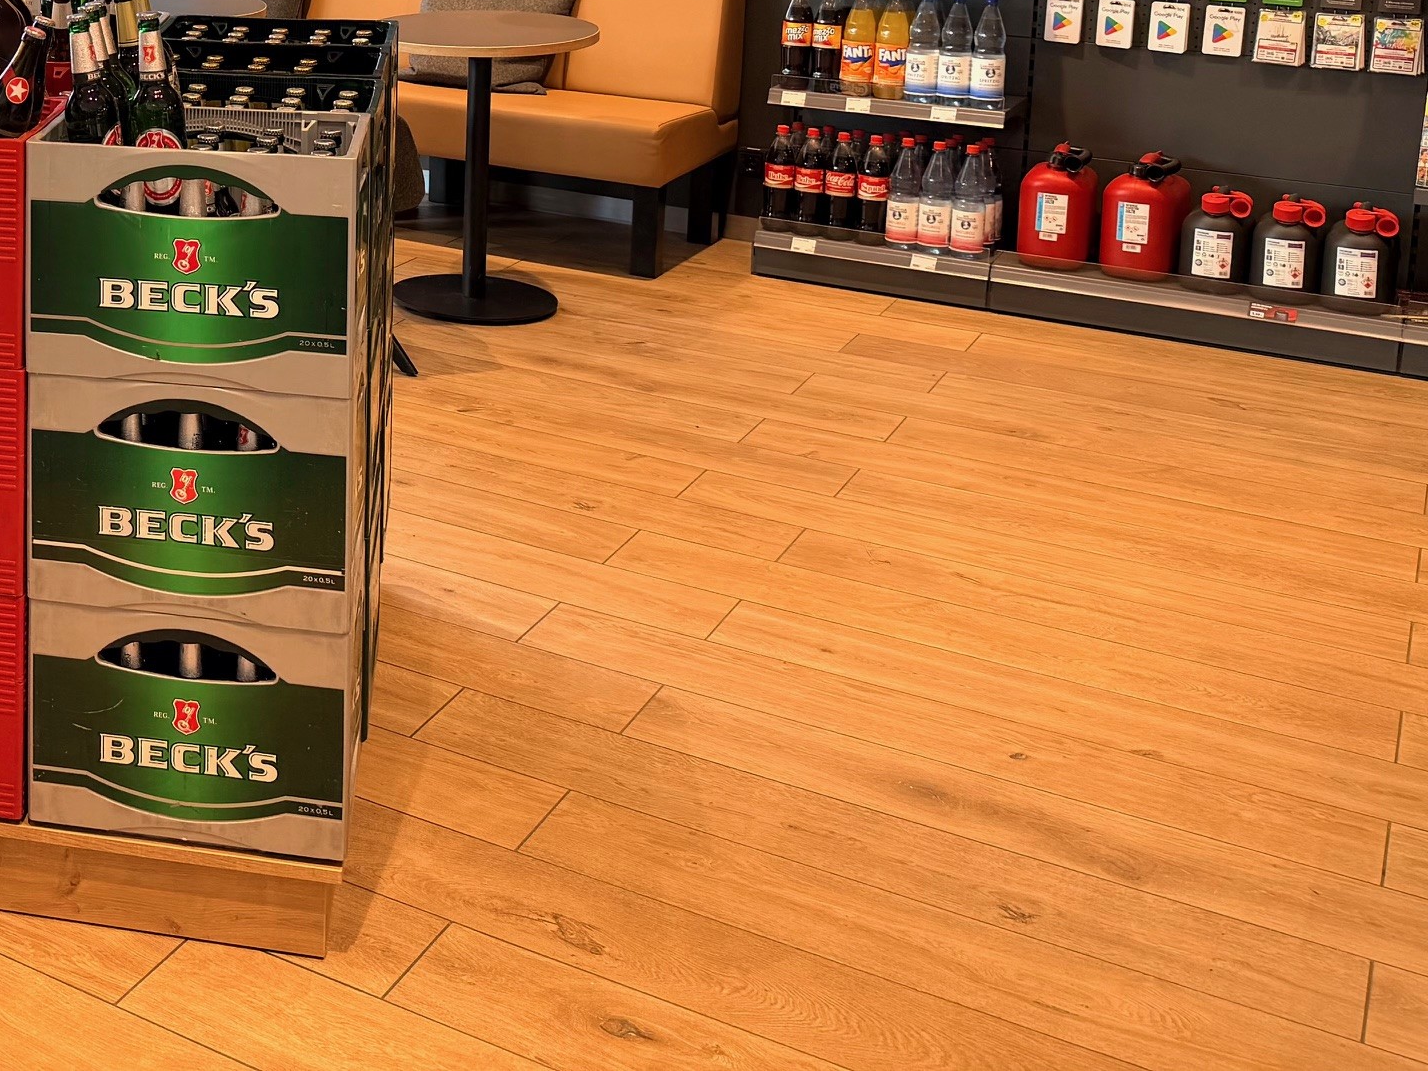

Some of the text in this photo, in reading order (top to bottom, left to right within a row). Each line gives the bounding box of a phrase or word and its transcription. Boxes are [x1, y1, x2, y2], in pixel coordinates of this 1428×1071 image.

[1049, 2, 1068, 10] Google
[785, 25, 810, 34] mezzo
[813, 26, 835, 36] mezzo
[787, 32, 804, 41] mix
[813, 35, 829, 43] mix
[825, 172, 855, 187] Coca-Cola
[99, 277, 280, 319] BECK'S
[97, 505, 275, 551] BECK'S
[99, 732, 278, 783] BECK'S
